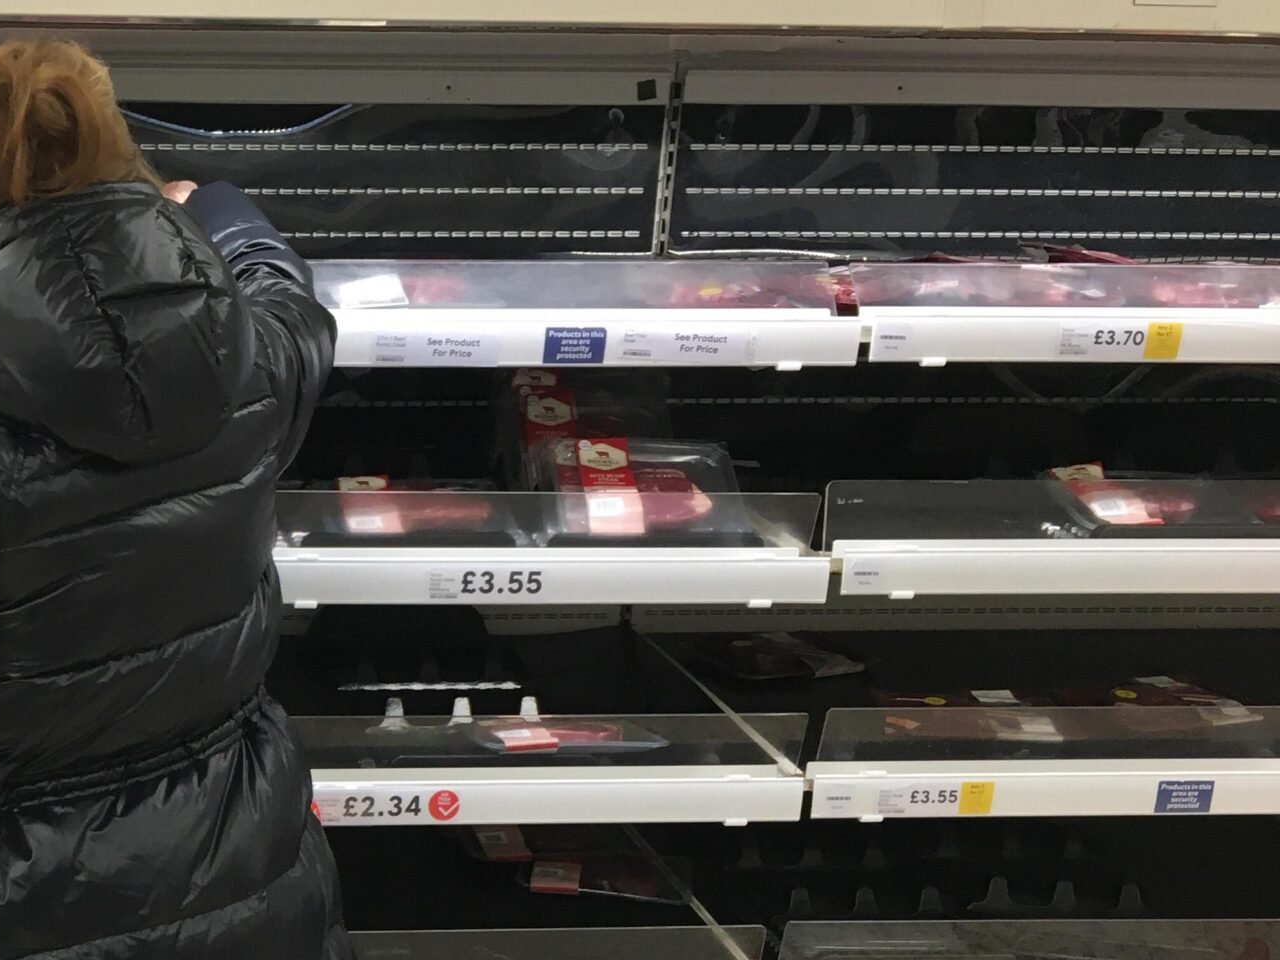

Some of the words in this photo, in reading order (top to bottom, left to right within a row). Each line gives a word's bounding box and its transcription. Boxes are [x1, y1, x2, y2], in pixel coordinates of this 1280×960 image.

[548, 330, 581, 338] Products
[590, 330, 605, 338] this
[675, 332, 691, 342] See
[692, 333, 728, 344] Product
[1094, 330, 1145, 346] £3.70
[426, 337, 443, 346] See
[445, 338, 481, 347] Product
[432, 348, 448, 357] For
[449, 349, 473, 357] Price
[679, 343, 695, 353] For
[696, 344, 719, 354] Price
[556, 352, 593, 360] protected
[461, 571, 542, 594] £3.55
[909, 789, 958, 804] £3.55
[343, 795, 422, 817] £2.34
[1166, 802, 1200, 810] protected
